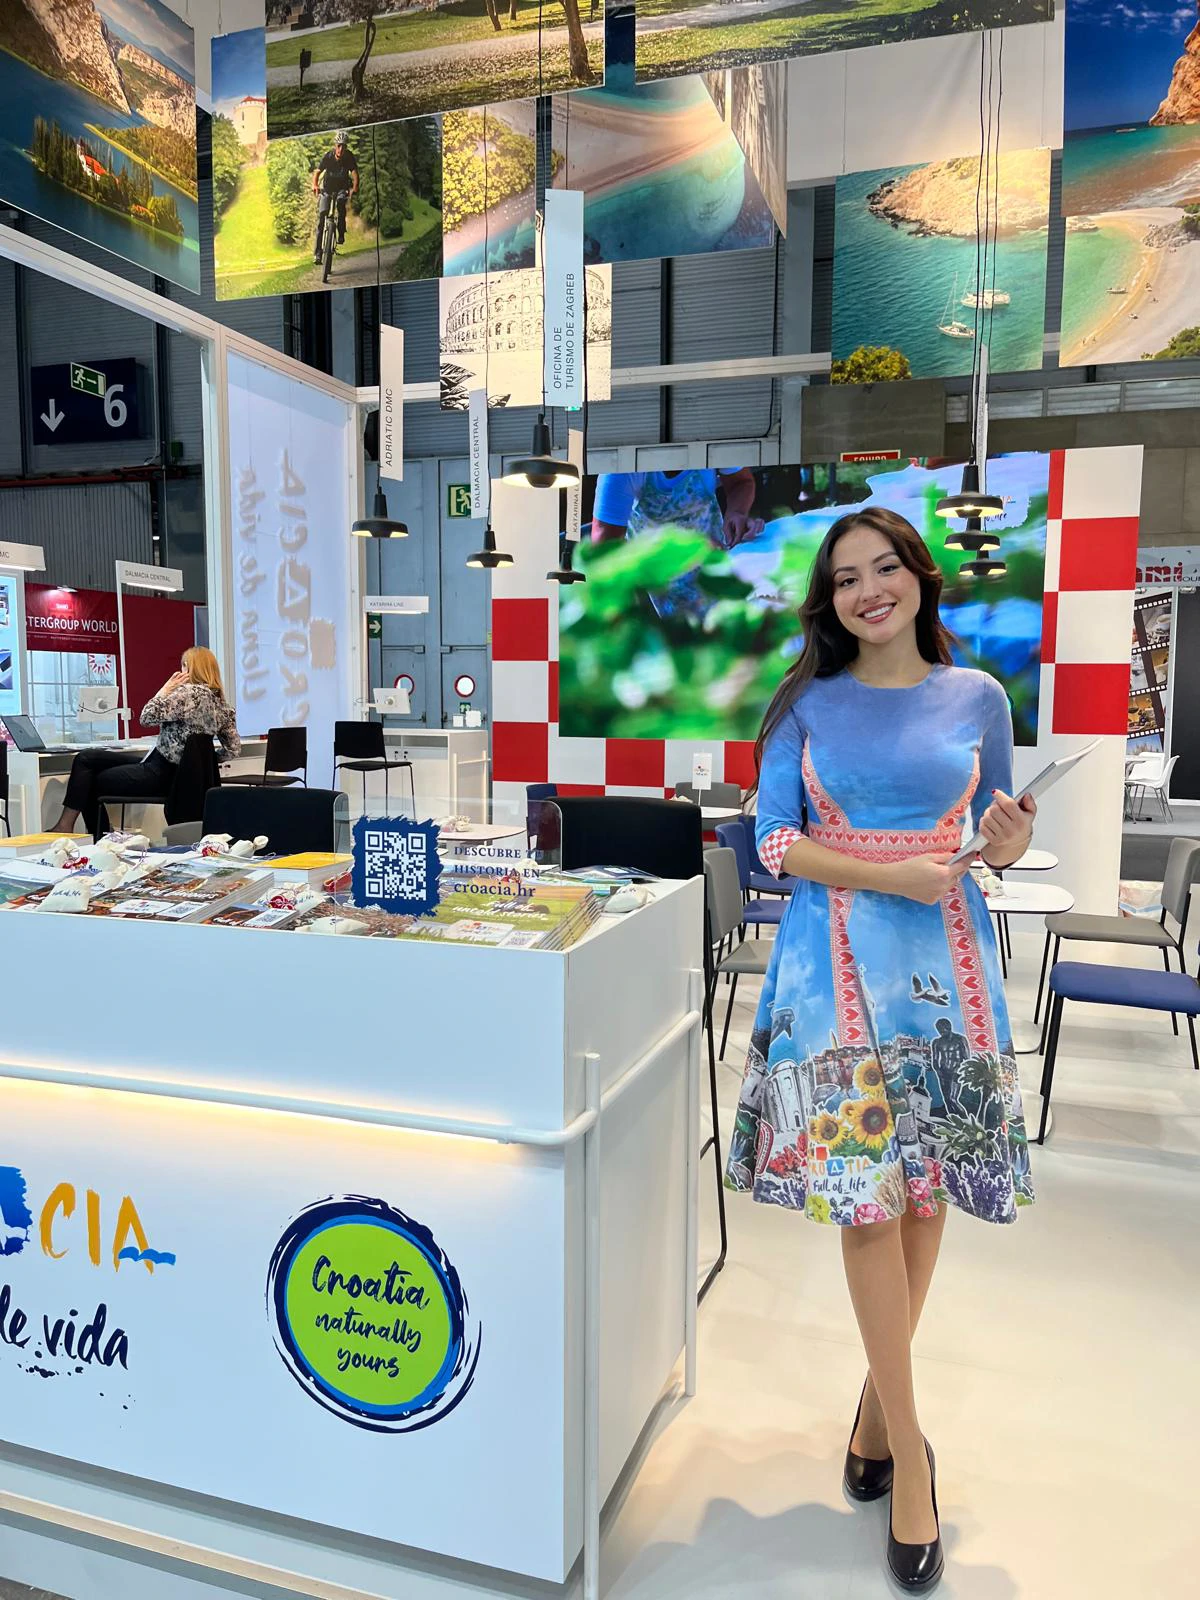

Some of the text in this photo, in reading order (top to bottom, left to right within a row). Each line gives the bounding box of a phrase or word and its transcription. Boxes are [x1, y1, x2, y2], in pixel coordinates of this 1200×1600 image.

[565, 273, 575, 390] TURISMO DE ZAGREB
[553, 327, 562, 389] OFICINA DE
[104, 384, 127, 427] 6
[385, 388, 393, 467] ADRIATIC DMC
[472, 416, 480, 509] DALMACIA CENTRAL
[25, 615, 118, 633] TERGROUP WORLD
[454, 846, 521, 859] DESCUBRE
[454, 864, 540, 879] HISTORIA EN
[454, 881, 536, 898] croacia.hr
[832, 1178, 843, 1195] of
[849, 1177, 867, 1193] life
[312, 1255, 430, 1310] Croatia
[43, 1303, 128, 1370] vida
[315, 1306, 421, 1353] naturally
[337, 1347, 400, 1378] yours
